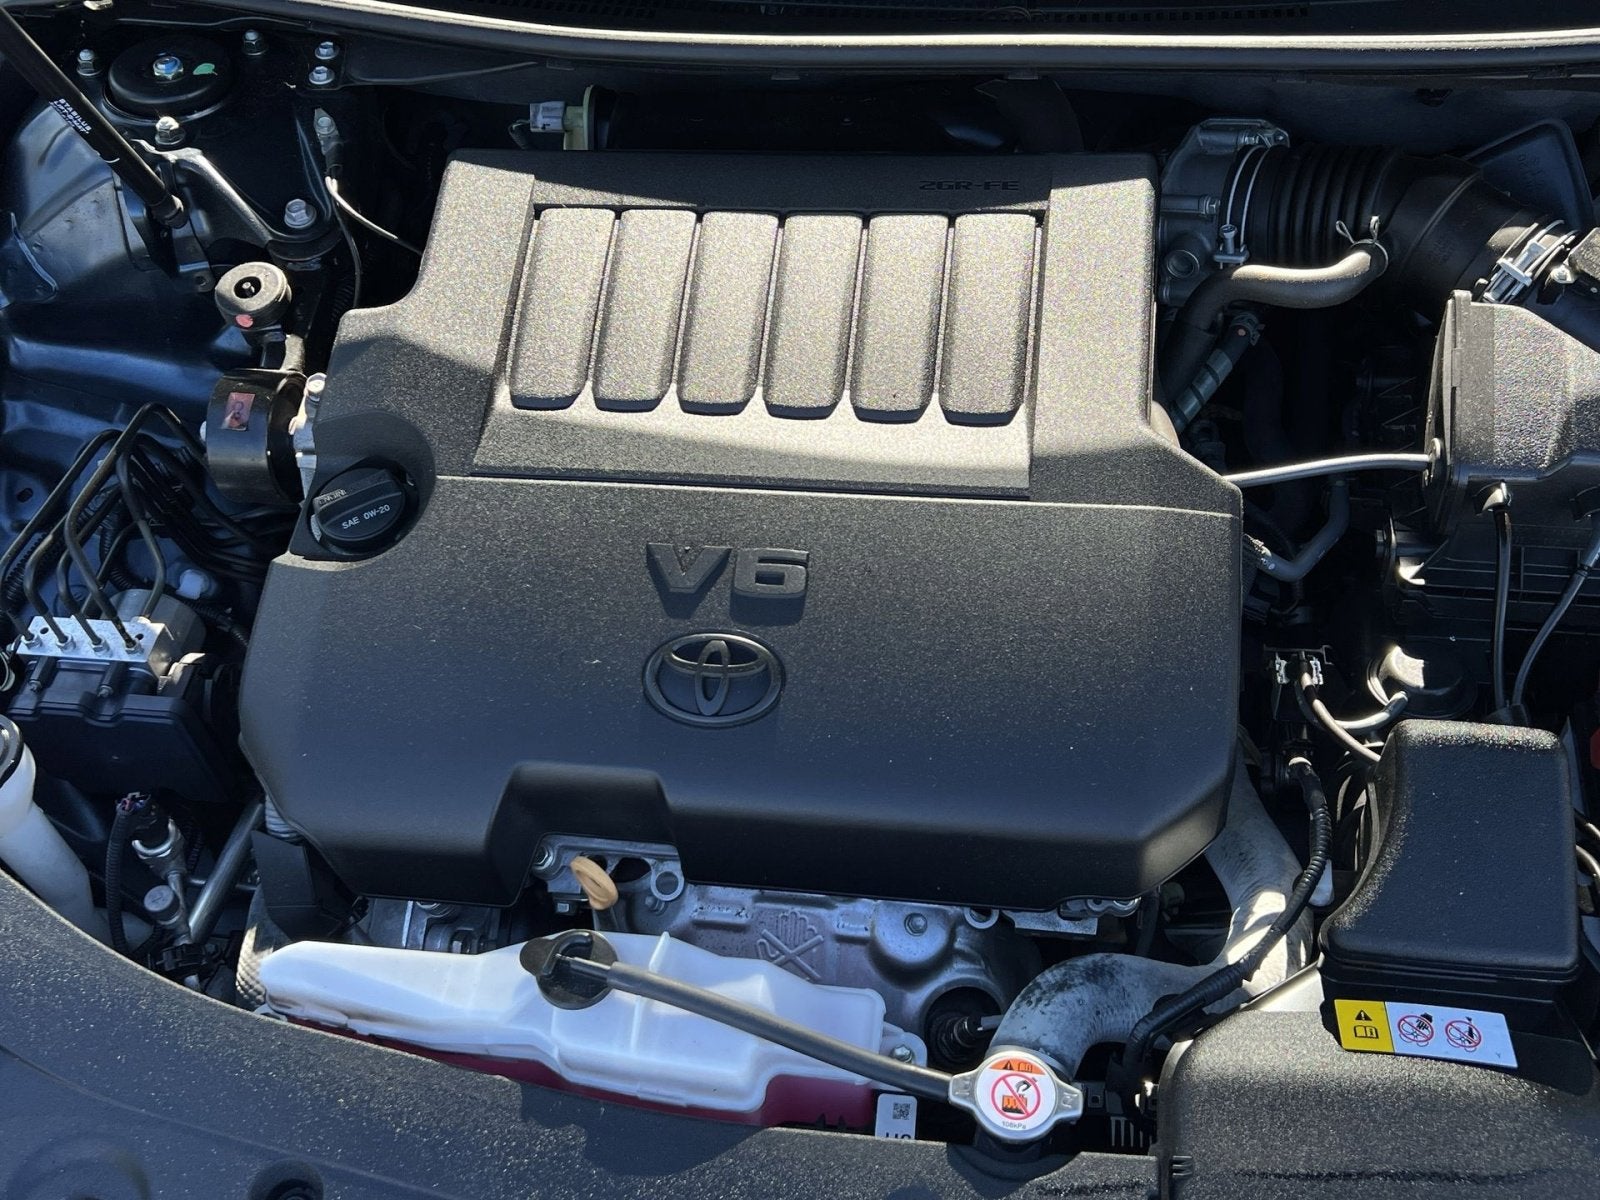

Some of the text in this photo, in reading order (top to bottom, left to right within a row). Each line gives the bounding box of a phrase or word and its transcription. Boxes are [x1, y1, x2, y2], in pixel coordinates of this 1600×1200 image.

[59, 98, 91, 131] STABILUS
[341, 504, 391, 529] SAE 0W-20
[646, 542, 810, 599] V6
